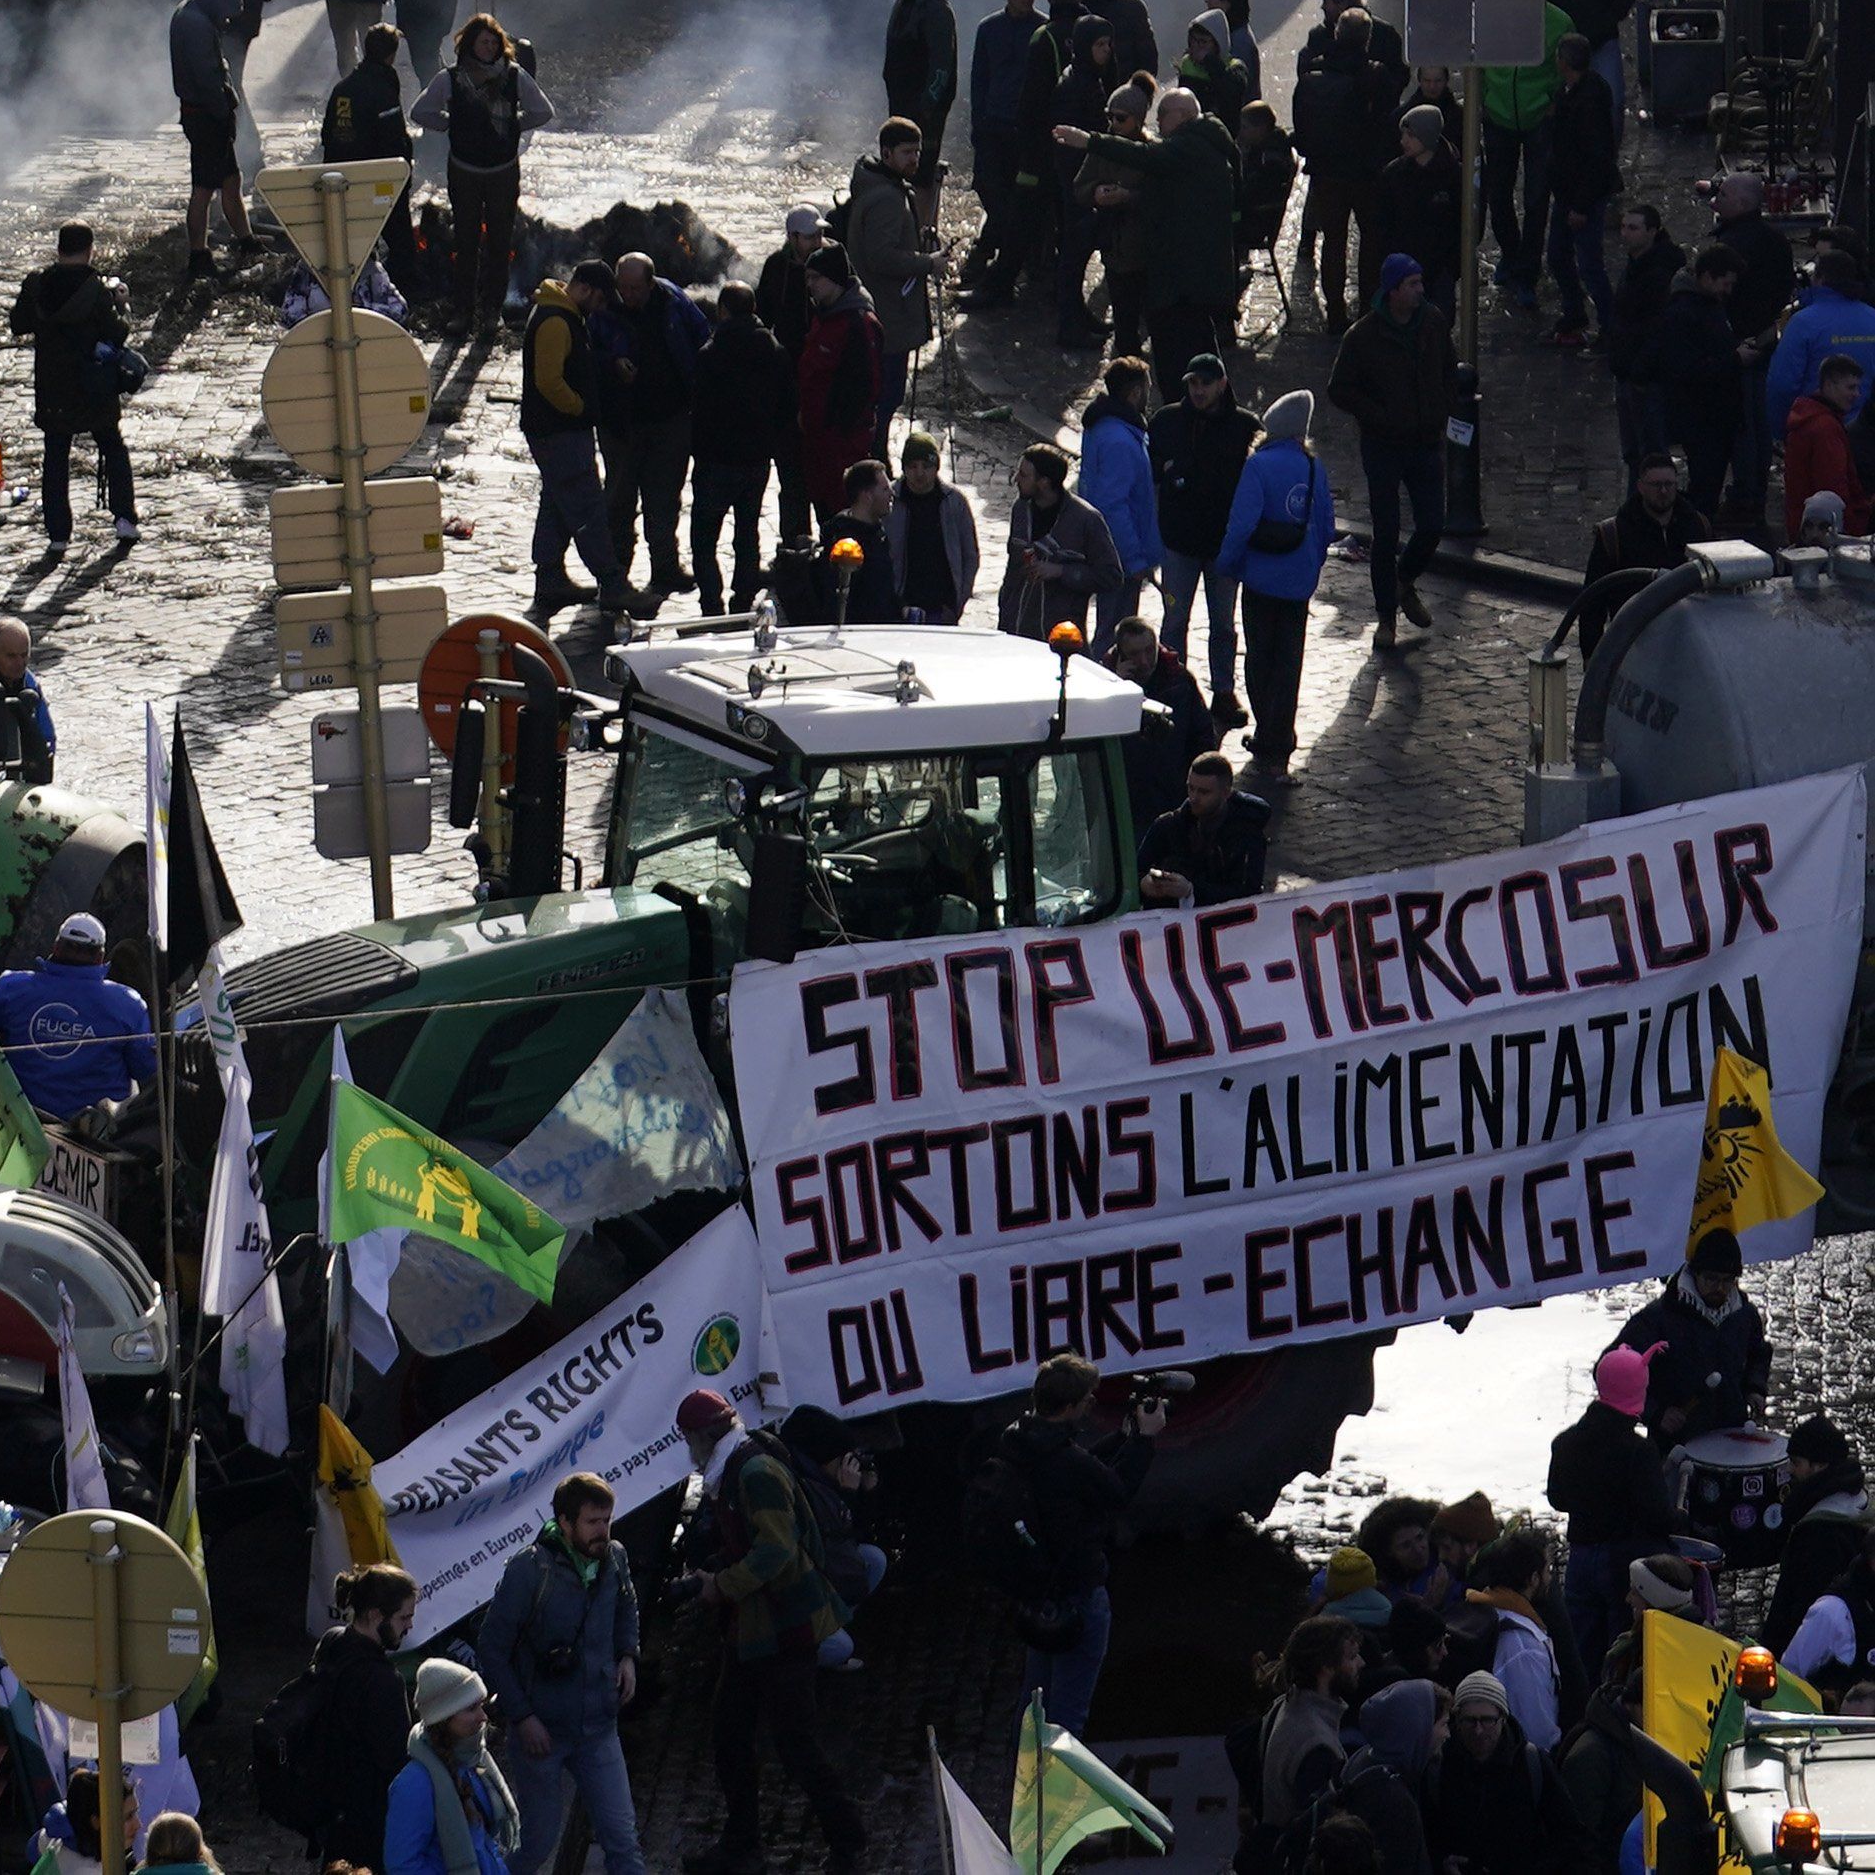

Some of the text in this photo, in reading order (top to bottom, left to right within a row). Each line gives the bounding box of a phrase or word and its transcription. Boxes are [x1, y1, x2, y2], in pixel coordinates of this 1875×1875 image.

[799, 937, 1094, 1116] STOP
[1121, 823, 1779, 1066] UE-MERCOSUR
[37, 1018, 97, 1039] FUGEA
[775, 1096, 1157, 1274] SORTONS
[828, 1289, 924, 1406] OU
[387, 1408, 543, 1517] PEASANTS
[526, 1302, 665, 1425] RIGHTS
[508, 1409, 607, 1495] Europe
[470, 1545, 488, 1568] en
[484, 1519, 535, 1558] Europa
